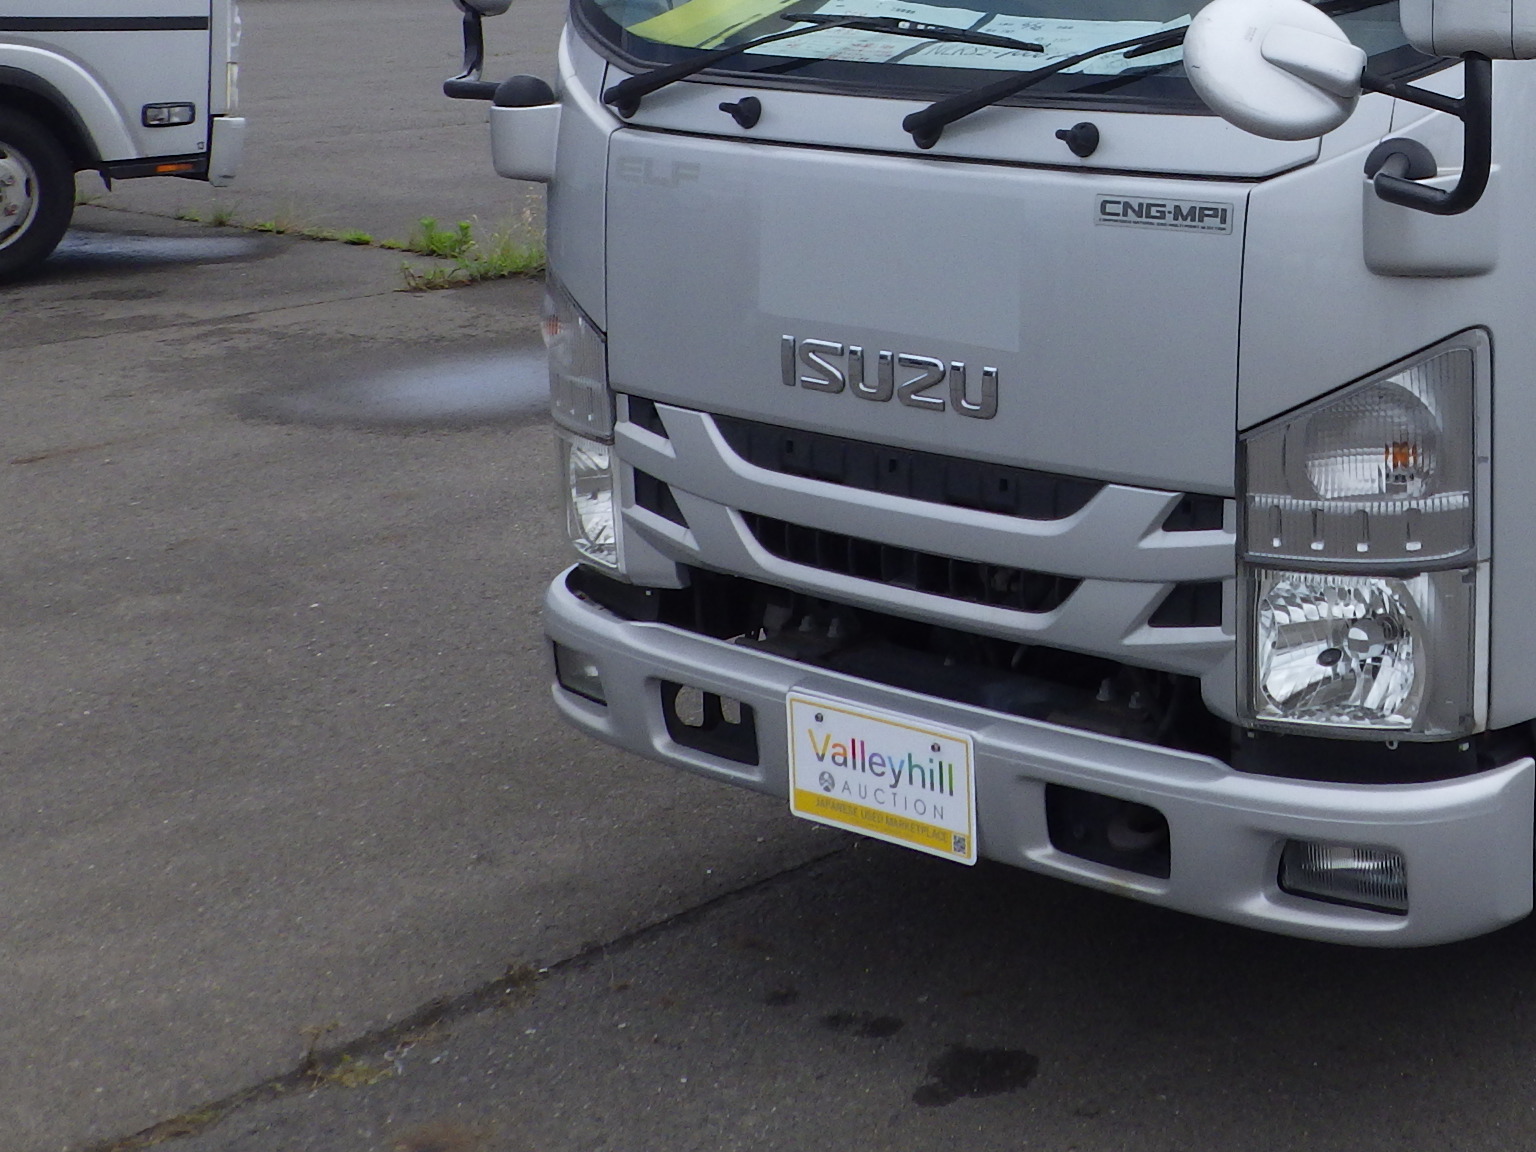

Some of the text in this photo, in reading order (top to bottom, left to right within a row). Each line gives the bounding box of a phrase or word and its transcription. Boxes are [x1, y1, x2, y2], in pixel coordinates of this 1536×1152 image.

[780, 333, 999, 420] ISUZU
[807, 727, 955, 797] Valleyhill
[815, 797, 858, 818] JAPANESE
[860, 807, 883, 824] USED
[841, 780, 945, 821] AUCTION
